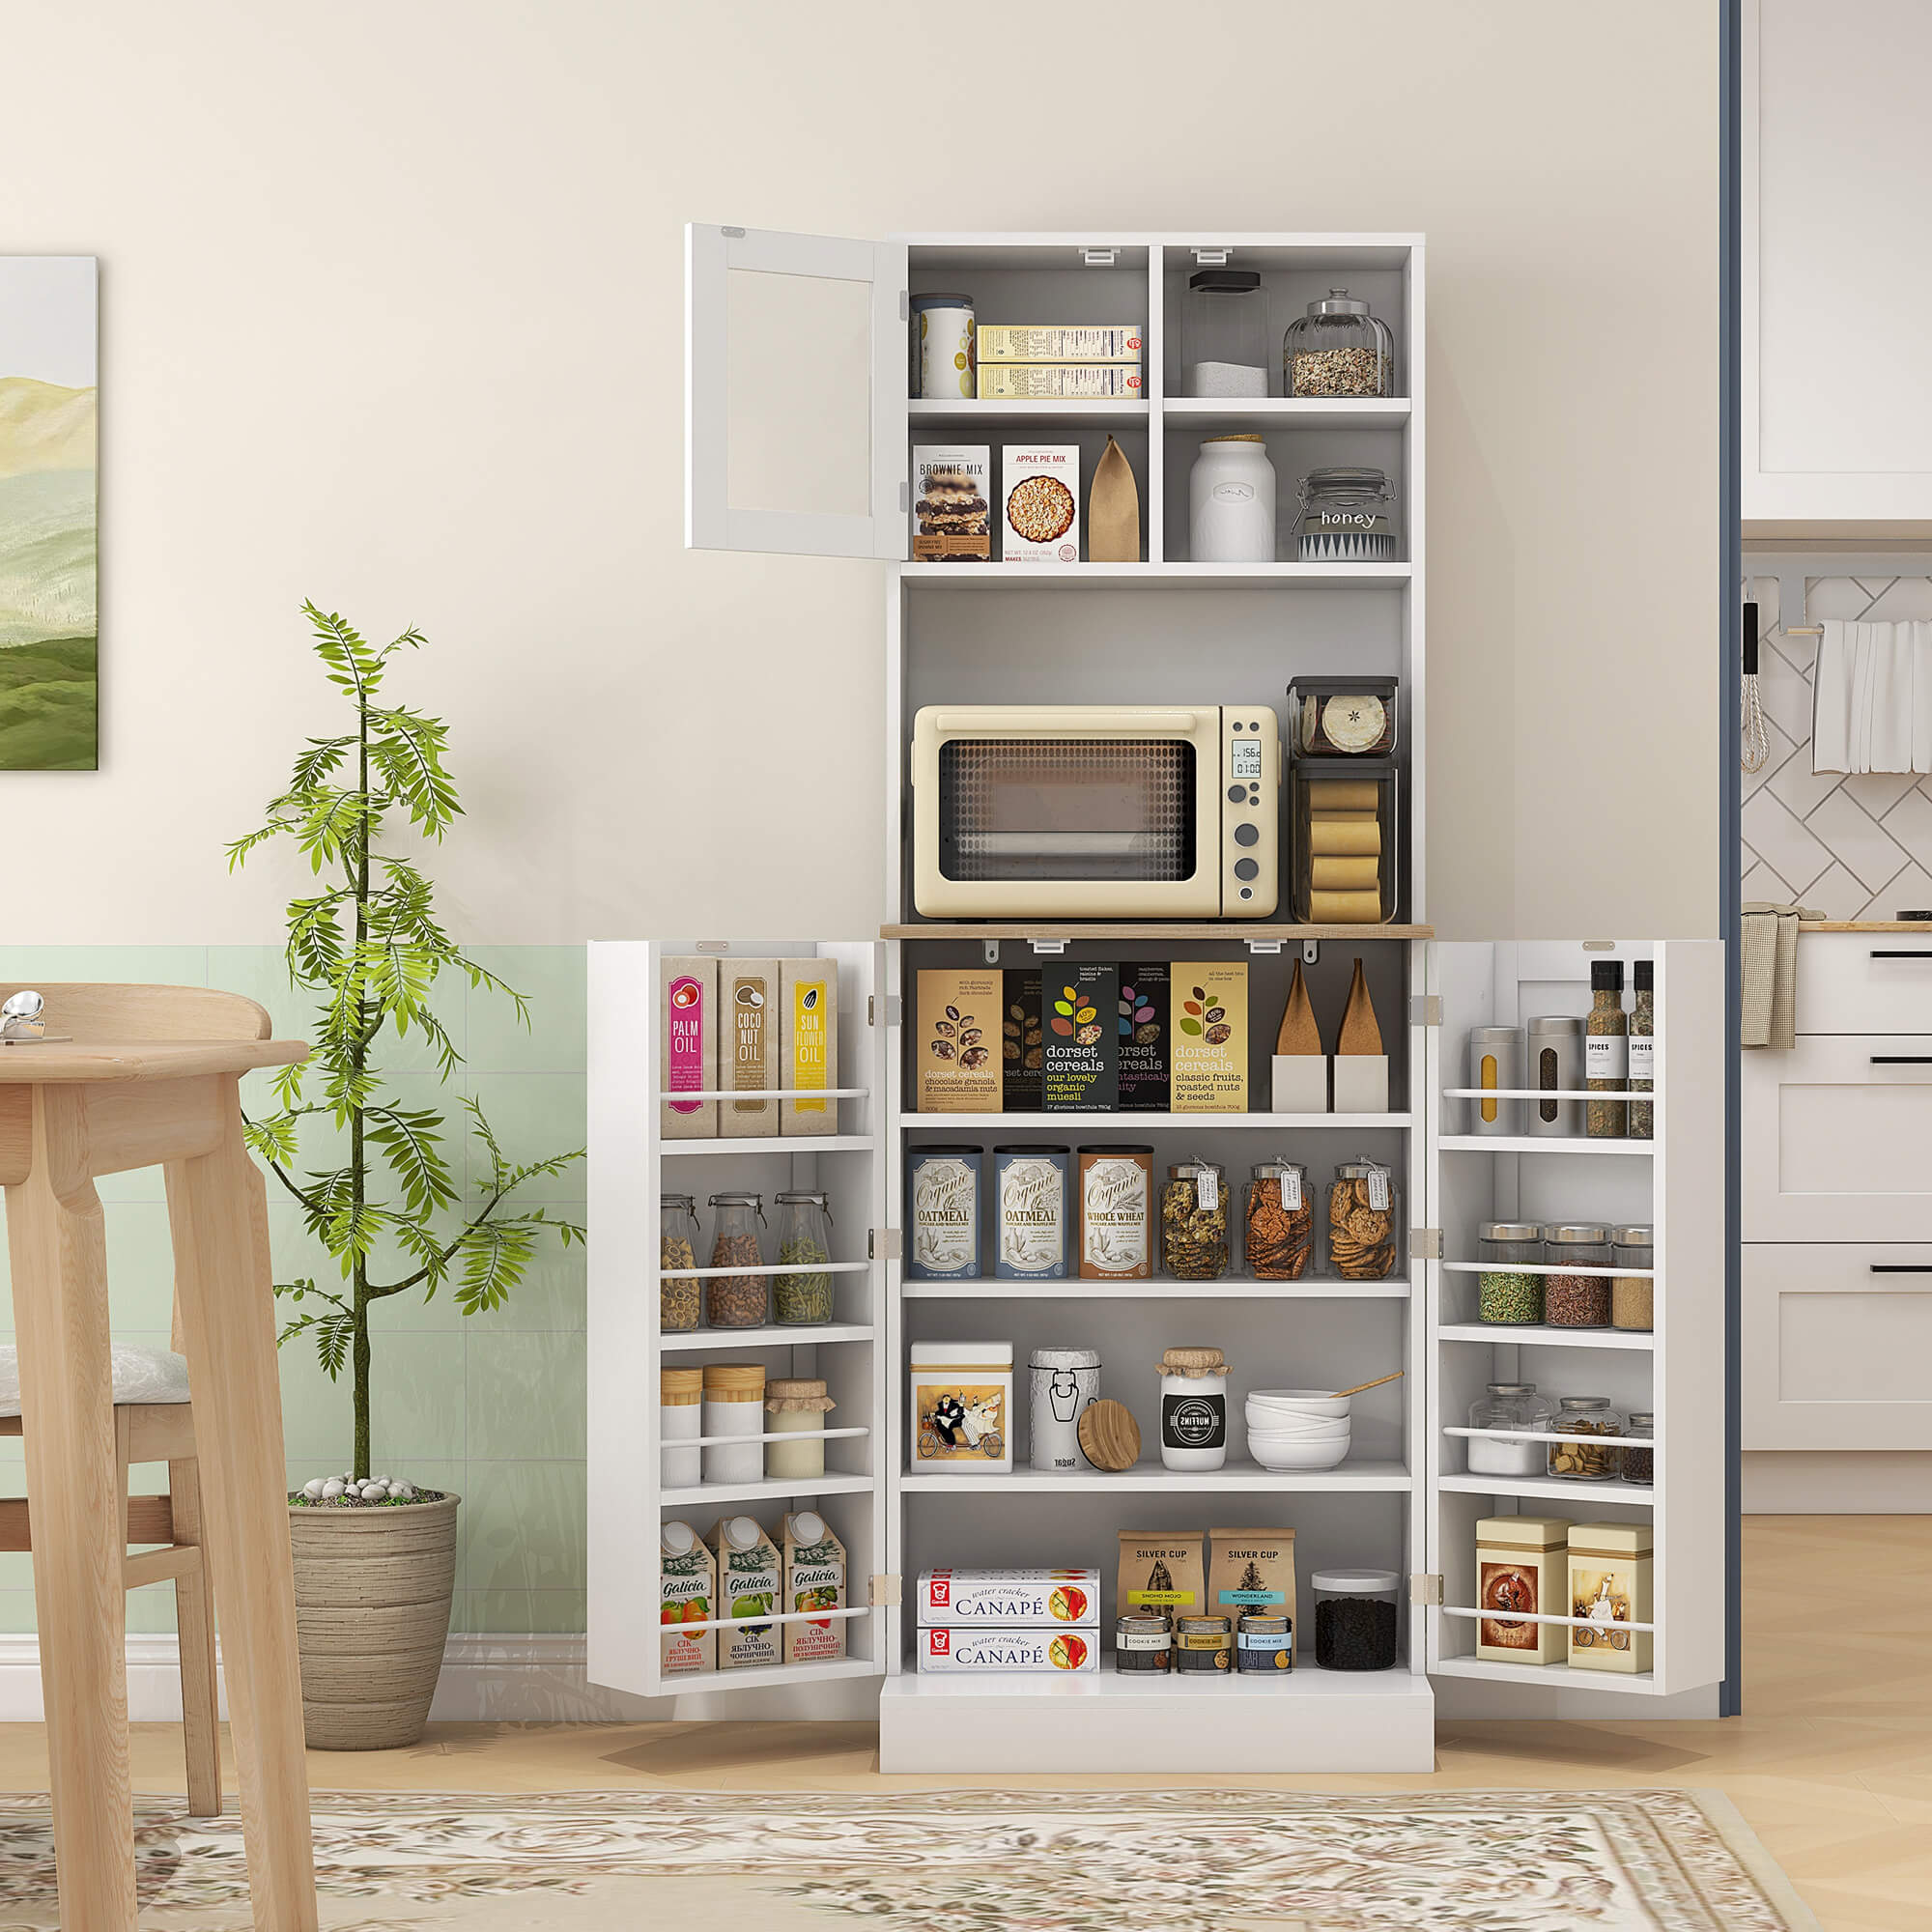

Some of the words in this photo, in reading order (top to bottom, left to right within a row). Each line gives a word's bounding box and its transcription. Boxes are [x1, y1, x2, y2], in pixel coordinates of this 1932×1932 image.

[920, 464, 962, 475] BROWNIE
[966, 464, 983, 475] MIX
[1321, 511, 1377, 528] honey
[738, 1013, 761, 1029] COCO
[802, 1014, 819, 1031] SUN
[673, 1021, 698, 1037] PALM
[741, 1030, 758, 1045] NUT
[797, 1032, 824, 1046] FLOWER
[675, 1037, 697, 1053] OIL
[1046, 1045, 1098, 1058] dorset
[1119, 1045, 1157, 1057] orset
[1175, 1045, 1228, 1058] dorset
[739, 1045, 761, 1062] OIL
[800, 1047, 821, 1063] OIL
[1046, 1059, 1104, 1072] cereals
[1119, 1058, 1163, 1070] reals
[1175, 1060, 1234, 1072] cereals
[965, 1078, 996, 1087] granola
[1067, 1073, 1097, 1085] lovely
[1176, 1073, 1210, 1082] classic
[1212, 1073, 1244, 1083] fruits,
[1047, 1083, 1086, 1094] organic
[1176, 1083, 1215, 1092] roasted
[1047, 1093, 1082, 1101] muesli
[917, 1171, 968, 1208] Organic
[1004, 1171, 1056, 1208] Organic
[1088, 1171, 1140, 1208] Organic
[919, 1210, 970, 1222] OATMEAL
[1006, 1210, 1057, 1222] OATMEAL
[1088, 1212, 1116, 1221] WHOLE
[1117, 1212, 1145, 1221] WHEAT
[795, 1569, 838, 1587] Galicia
[663, 1579, 707, 1598] Galicia
[730, 1577, 775, 1594] Galicia
[972, 1588, 997, 1599] water
[998, 1588, 1031, 1599] cracker
[955, 1598, 1044, 1615] CANAPÉ
[796, 1635, 838, 1645] ЯБЛУЧНО-
[972, 1636, 997, 1647] water
[998, 1636, 1031, 1647] cracker
[731, 1642, 774, 1653] ЯБЛУЧНО-
[730, 1649, 775, 1660] ЧОРНИЧНИЙ
[955, 1646, 1044, 1663] CANAPÉ
